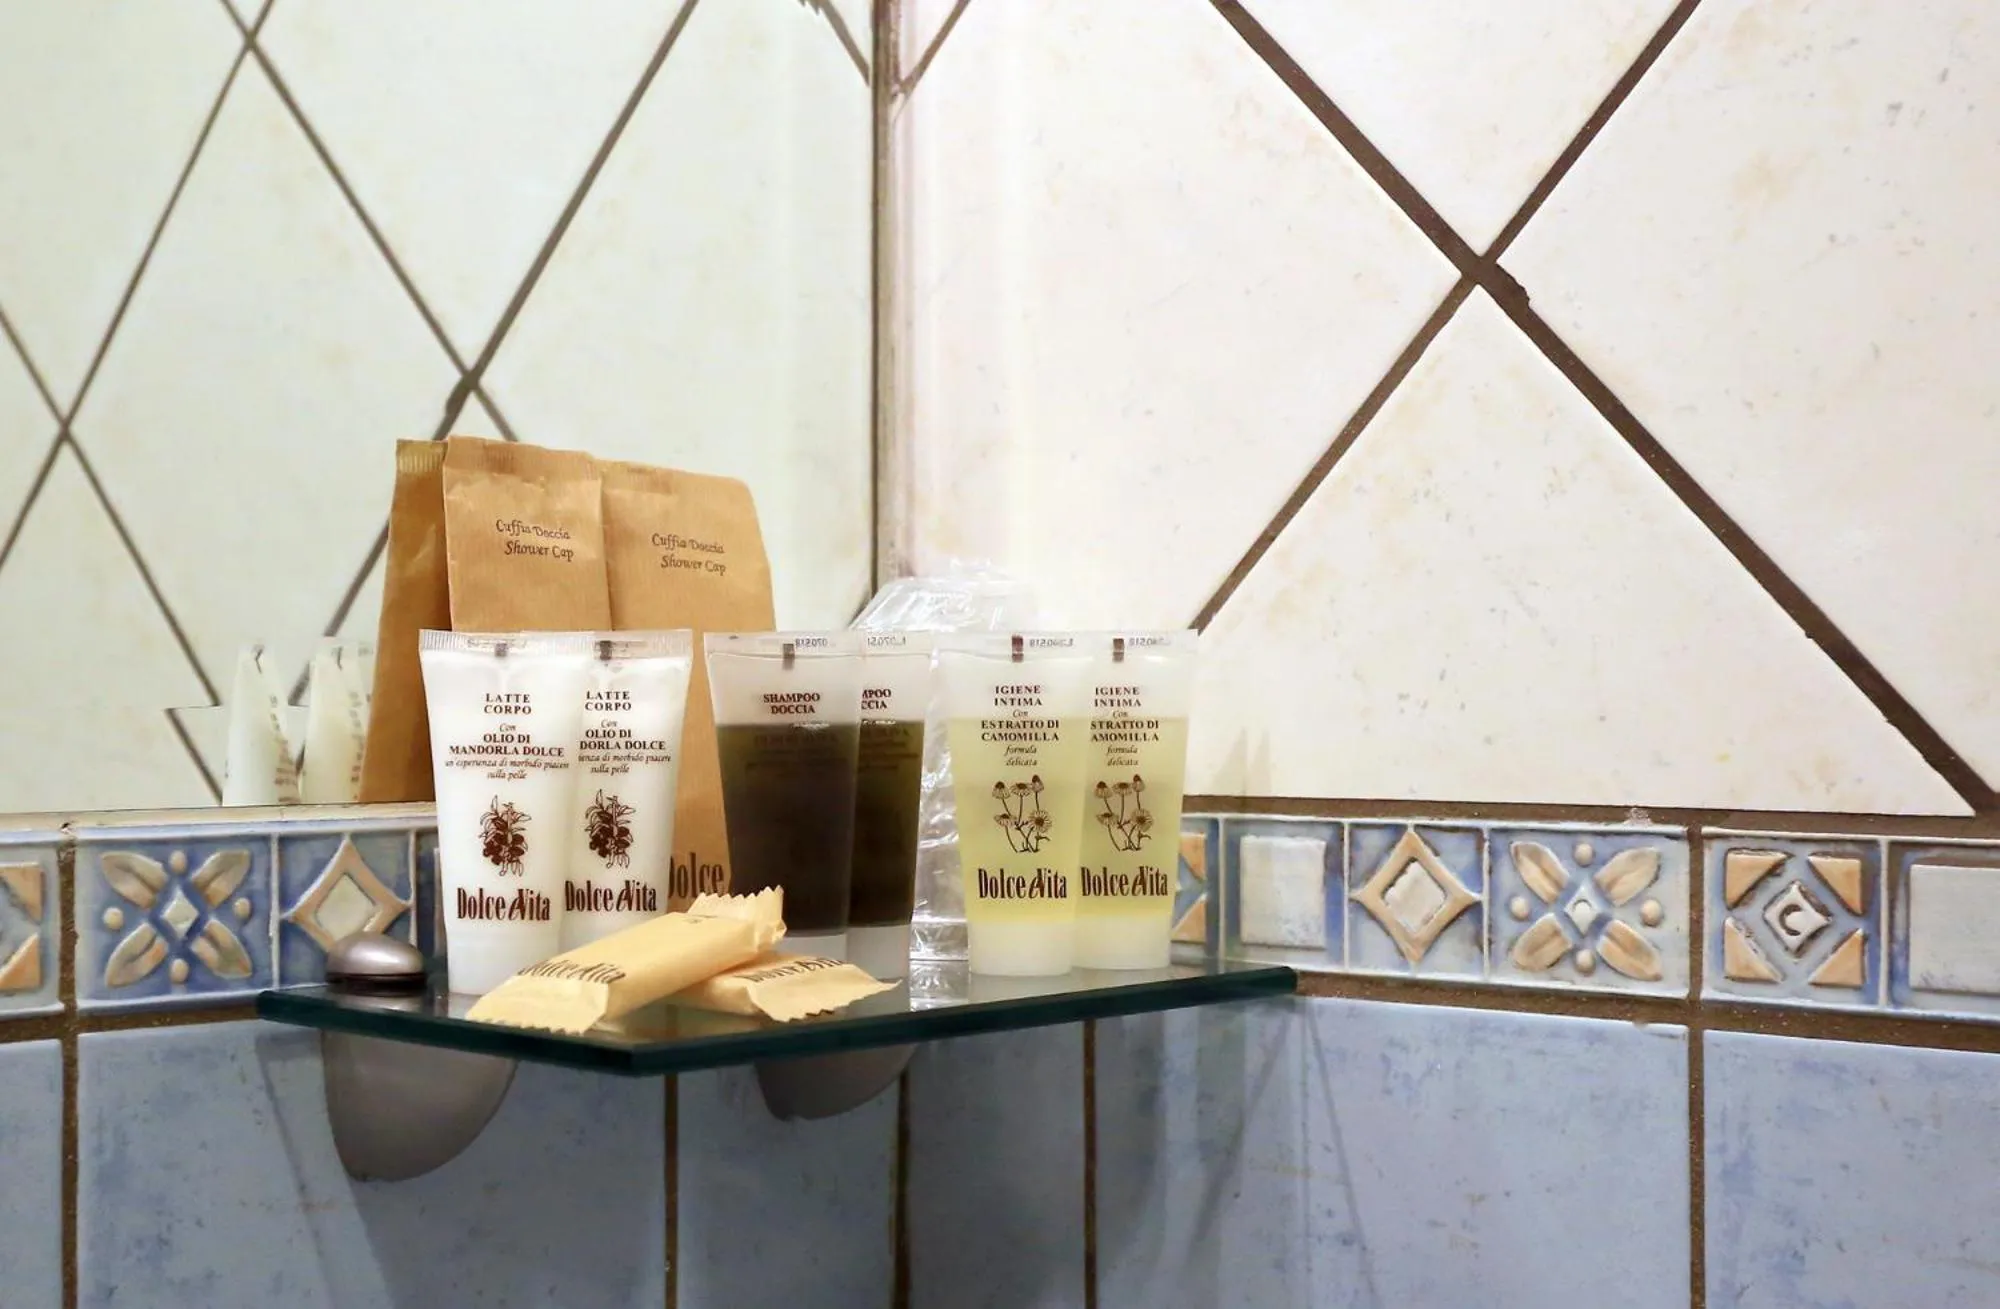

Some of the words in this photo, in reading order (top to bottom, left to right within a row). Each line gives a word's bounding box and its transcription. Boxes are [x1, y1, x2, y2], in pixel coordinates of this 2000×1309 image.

[495, 518, 532, 536] Cuffia
[532, 525, 571, 540] Doccia
[651, 532, 687, 551] Cuffia
[687, 538, 725, 554] Doccia
[504, 540, 550, 556] Shower
[551, 545, 574, 563] Cap
[660, 553, 703, 569] Shower
[704, 559, 727, 577] Cap
[995, 684, 1041, 695] IGIENE
[1095, 686, 1141, 696] IGIENE
[485, 693, 531, 704] LATTE
[586, 690, 631, 701] LATTE
[763, 693, 820, 704] SHAMPOO
[584, 701, 632, 712] CORPO
[994, 697, 1042, 706] INTIMA
[1094, 698, 1142, 707] INTIMA
[483, 704, 532, 715] CORPO
[771, 704, 816, 715] DOCCIA
[1012, 709, 1029, 719] Con
[1112, 709, 1129, 719] Con
[499, 722, 517, 733] Con
[600, 719, 618, 729] Con
[981, 719, 1044, 730] ESTRATTO
[1047, 719, 1060, 729] DI
[1147, 719, 1159, 729] DI
[483, 734, 515, 744] OLIO
[517, 734, 531, 744] DI
[585, 729, 616, 739] OLIO
[619, 729, 632, 739] DI
[981, 732, 1060, 742] CAMOMILLA
[1090, 732, 1160, 742] AMOMILLA
[449, 744, 519, 756] MANDORLA
[522, 746, 565, 757] DOLCE
[624, 740, 667, 751] DOLCE
[1003, 744, 1037, 757] formula
[1106, 744, 1138, 757] formula
[601, 752, 611, 762] di
[612, 752, 645, 762] morbido
[1006, 757, 1038, 767] delicata
[1107, 757, 1139, 767] delicata
[498, 757, 508, 767] di
[509, 757, 542, 769] morbido
[508, 769, 528, 782] pelle
[610, 763, 631, 777] pelle
[978, 867, 1026, 899] Dolce
[1080, 866, 1129, 897] Dolce
[564, 879, 614, 912] Dolce
[457, 887, 506, 920] Dolce
